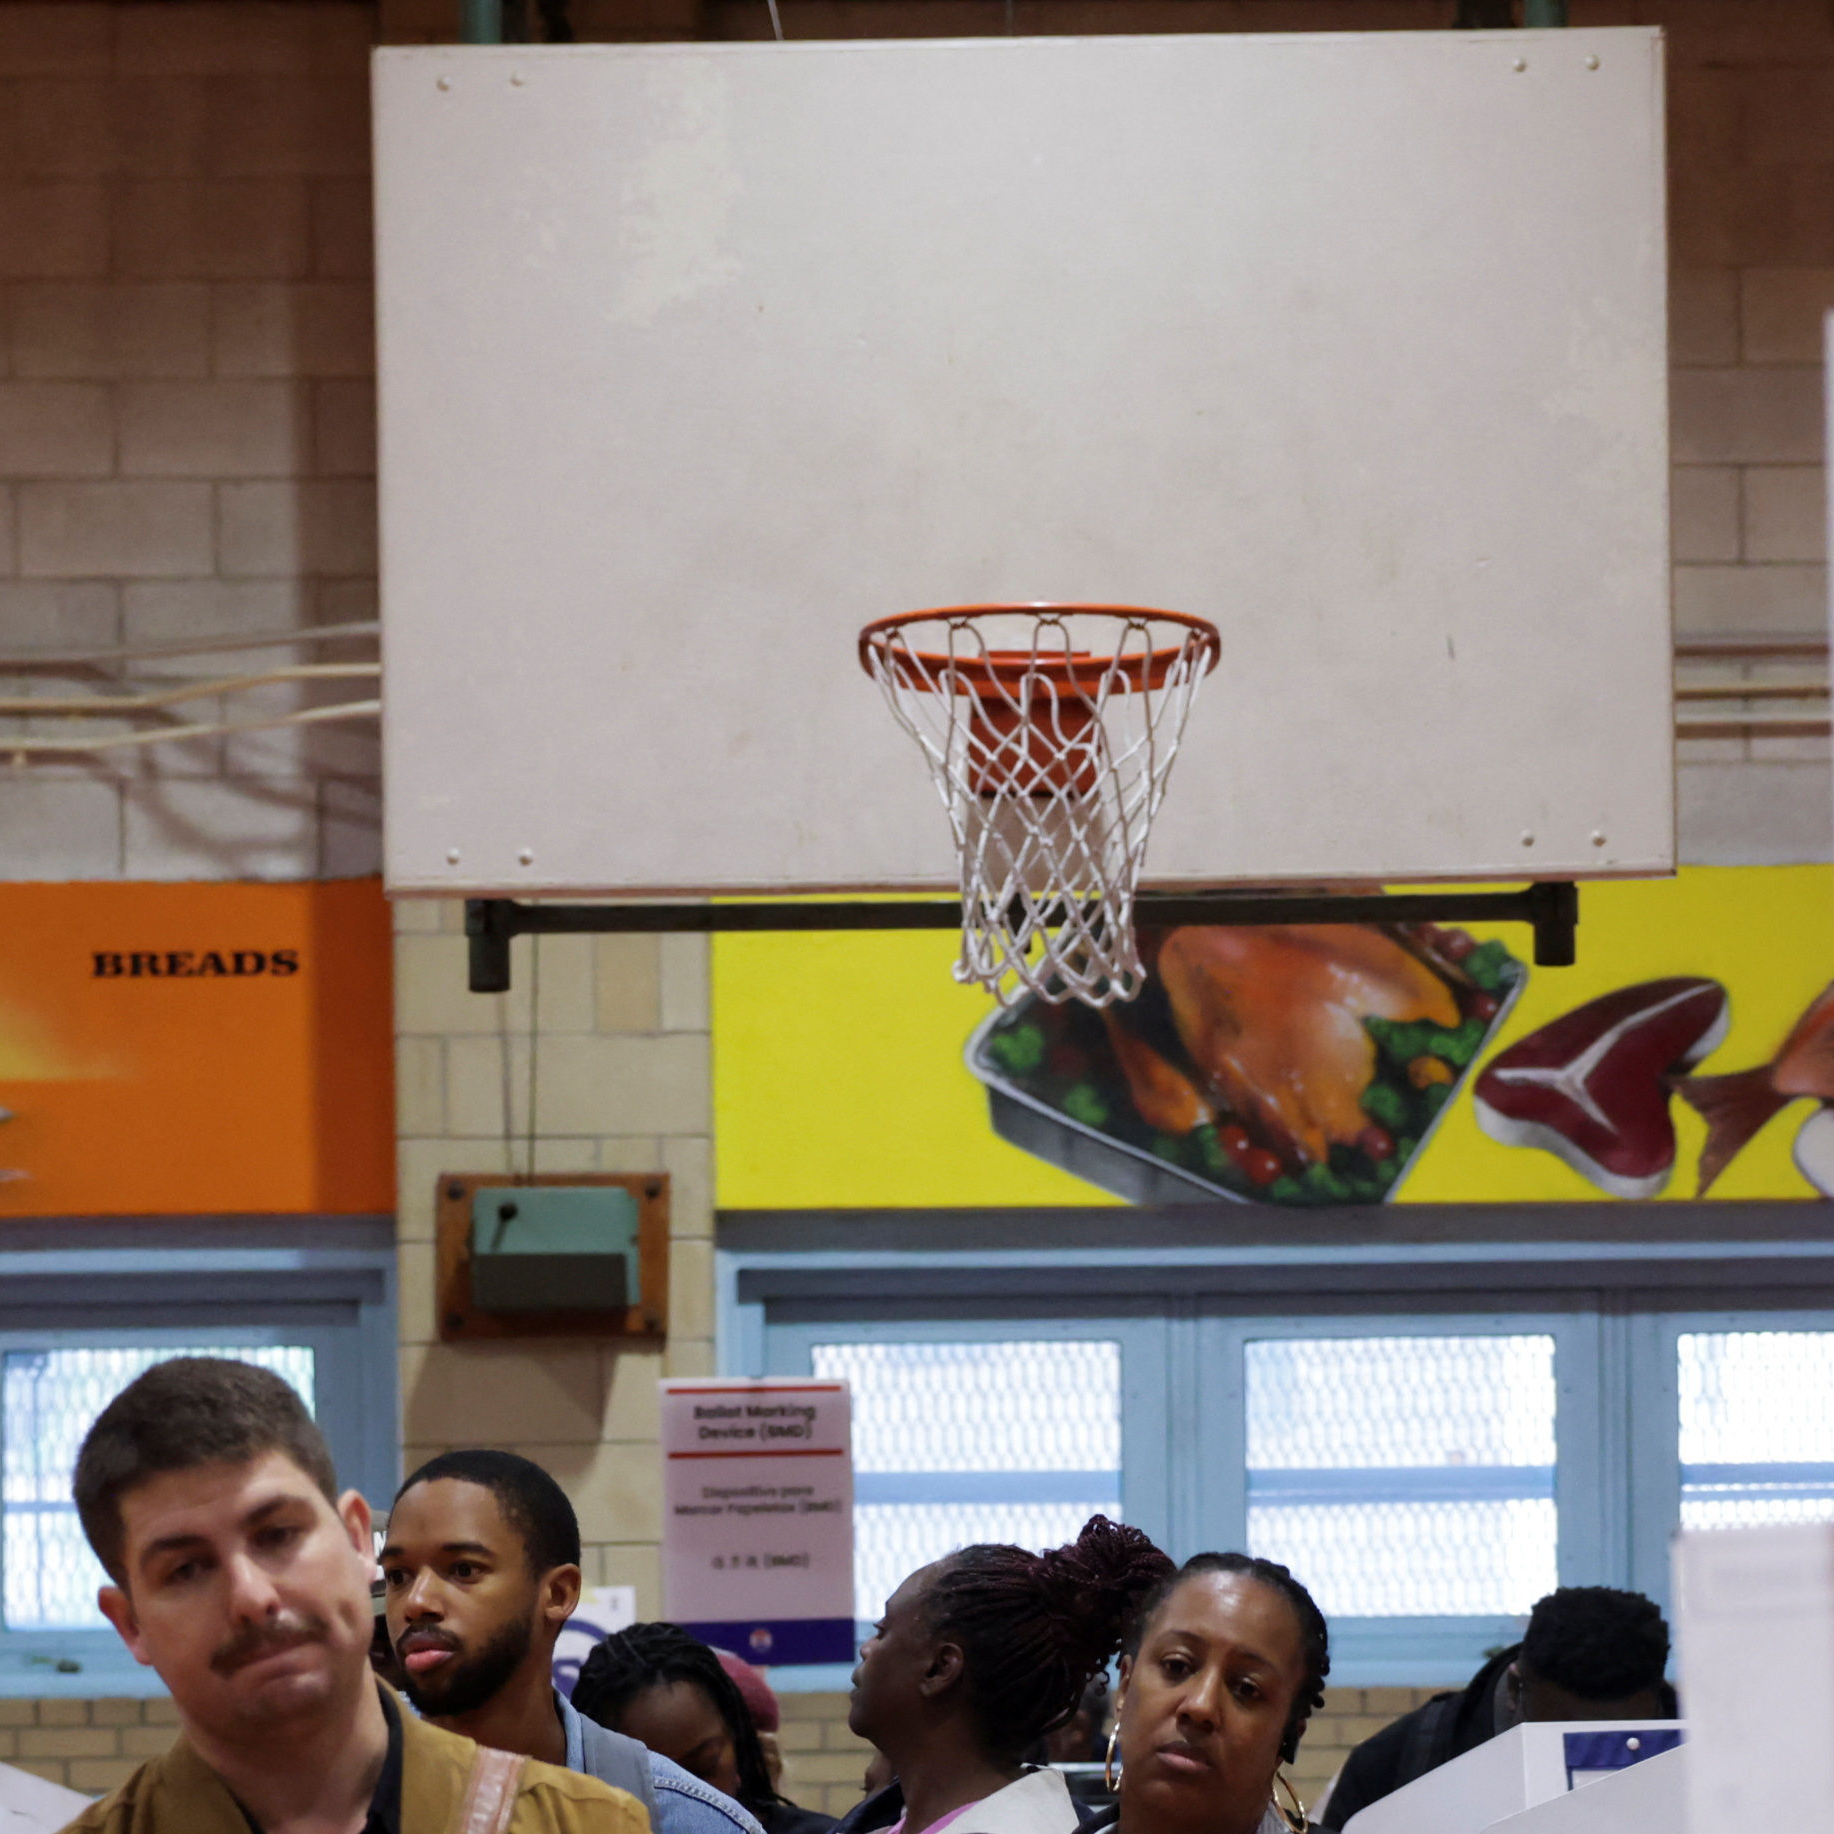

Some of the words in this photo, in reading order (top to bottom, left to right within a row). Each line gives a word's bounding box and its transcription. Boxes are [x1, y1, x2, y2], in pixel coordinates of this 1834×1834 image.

[92, 951, 299, 977] BREADS
[693, 1405, 742, 1420] Ballot
[745, 1404, 816, 1421] Marking
[698, 1425, 756, 1440] Device
